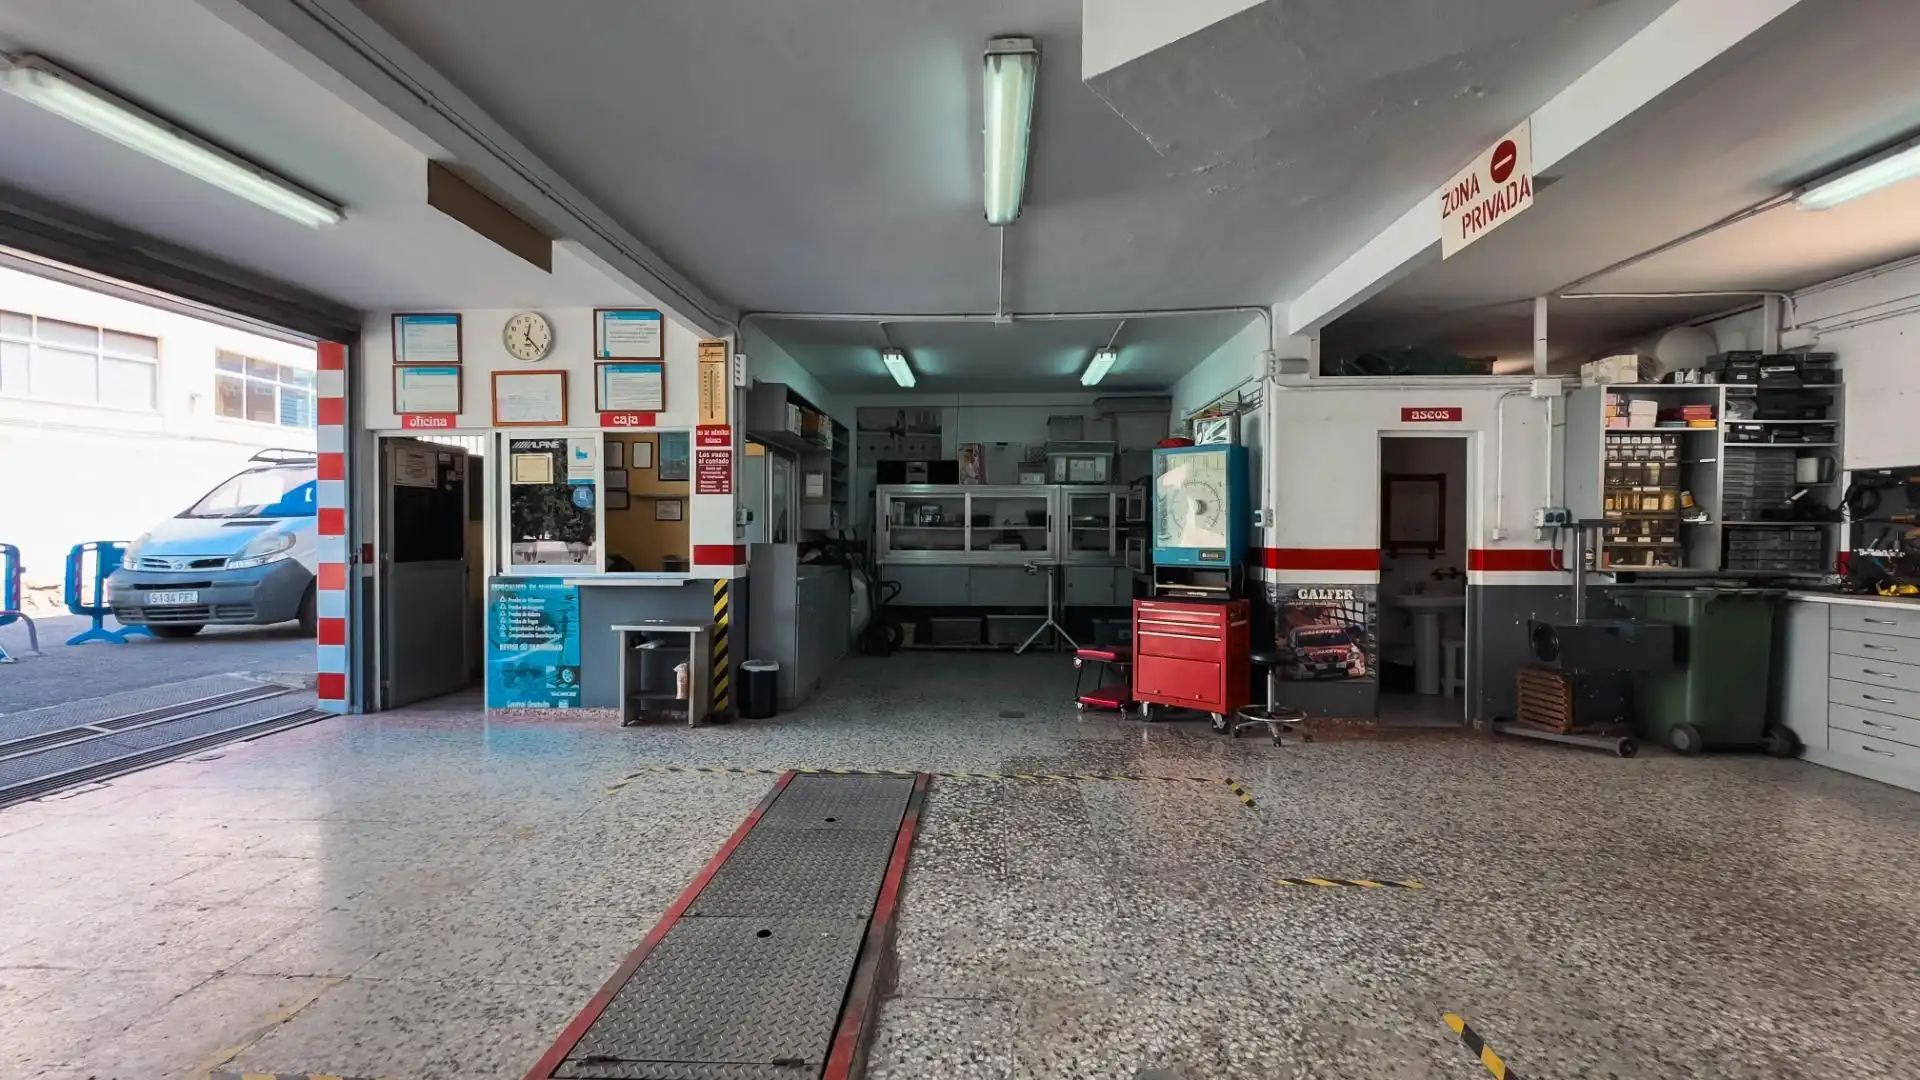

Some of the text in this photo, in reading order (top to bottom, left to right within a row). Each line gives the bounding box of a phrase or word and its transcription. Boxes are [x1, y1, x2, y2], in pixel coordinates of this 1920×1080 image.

[1441, 172, 1481, 219] ZONA
[1461, 173, 1531, 239] PRIVADA
[409, 415, 448, 427] oficina
[613, 413, 638, 426] caja
[1411, 410, 1450, 420] aseos
[527, 441, 560, 449] ALPINE
[1297, 588, 1355, 600] GALFER
